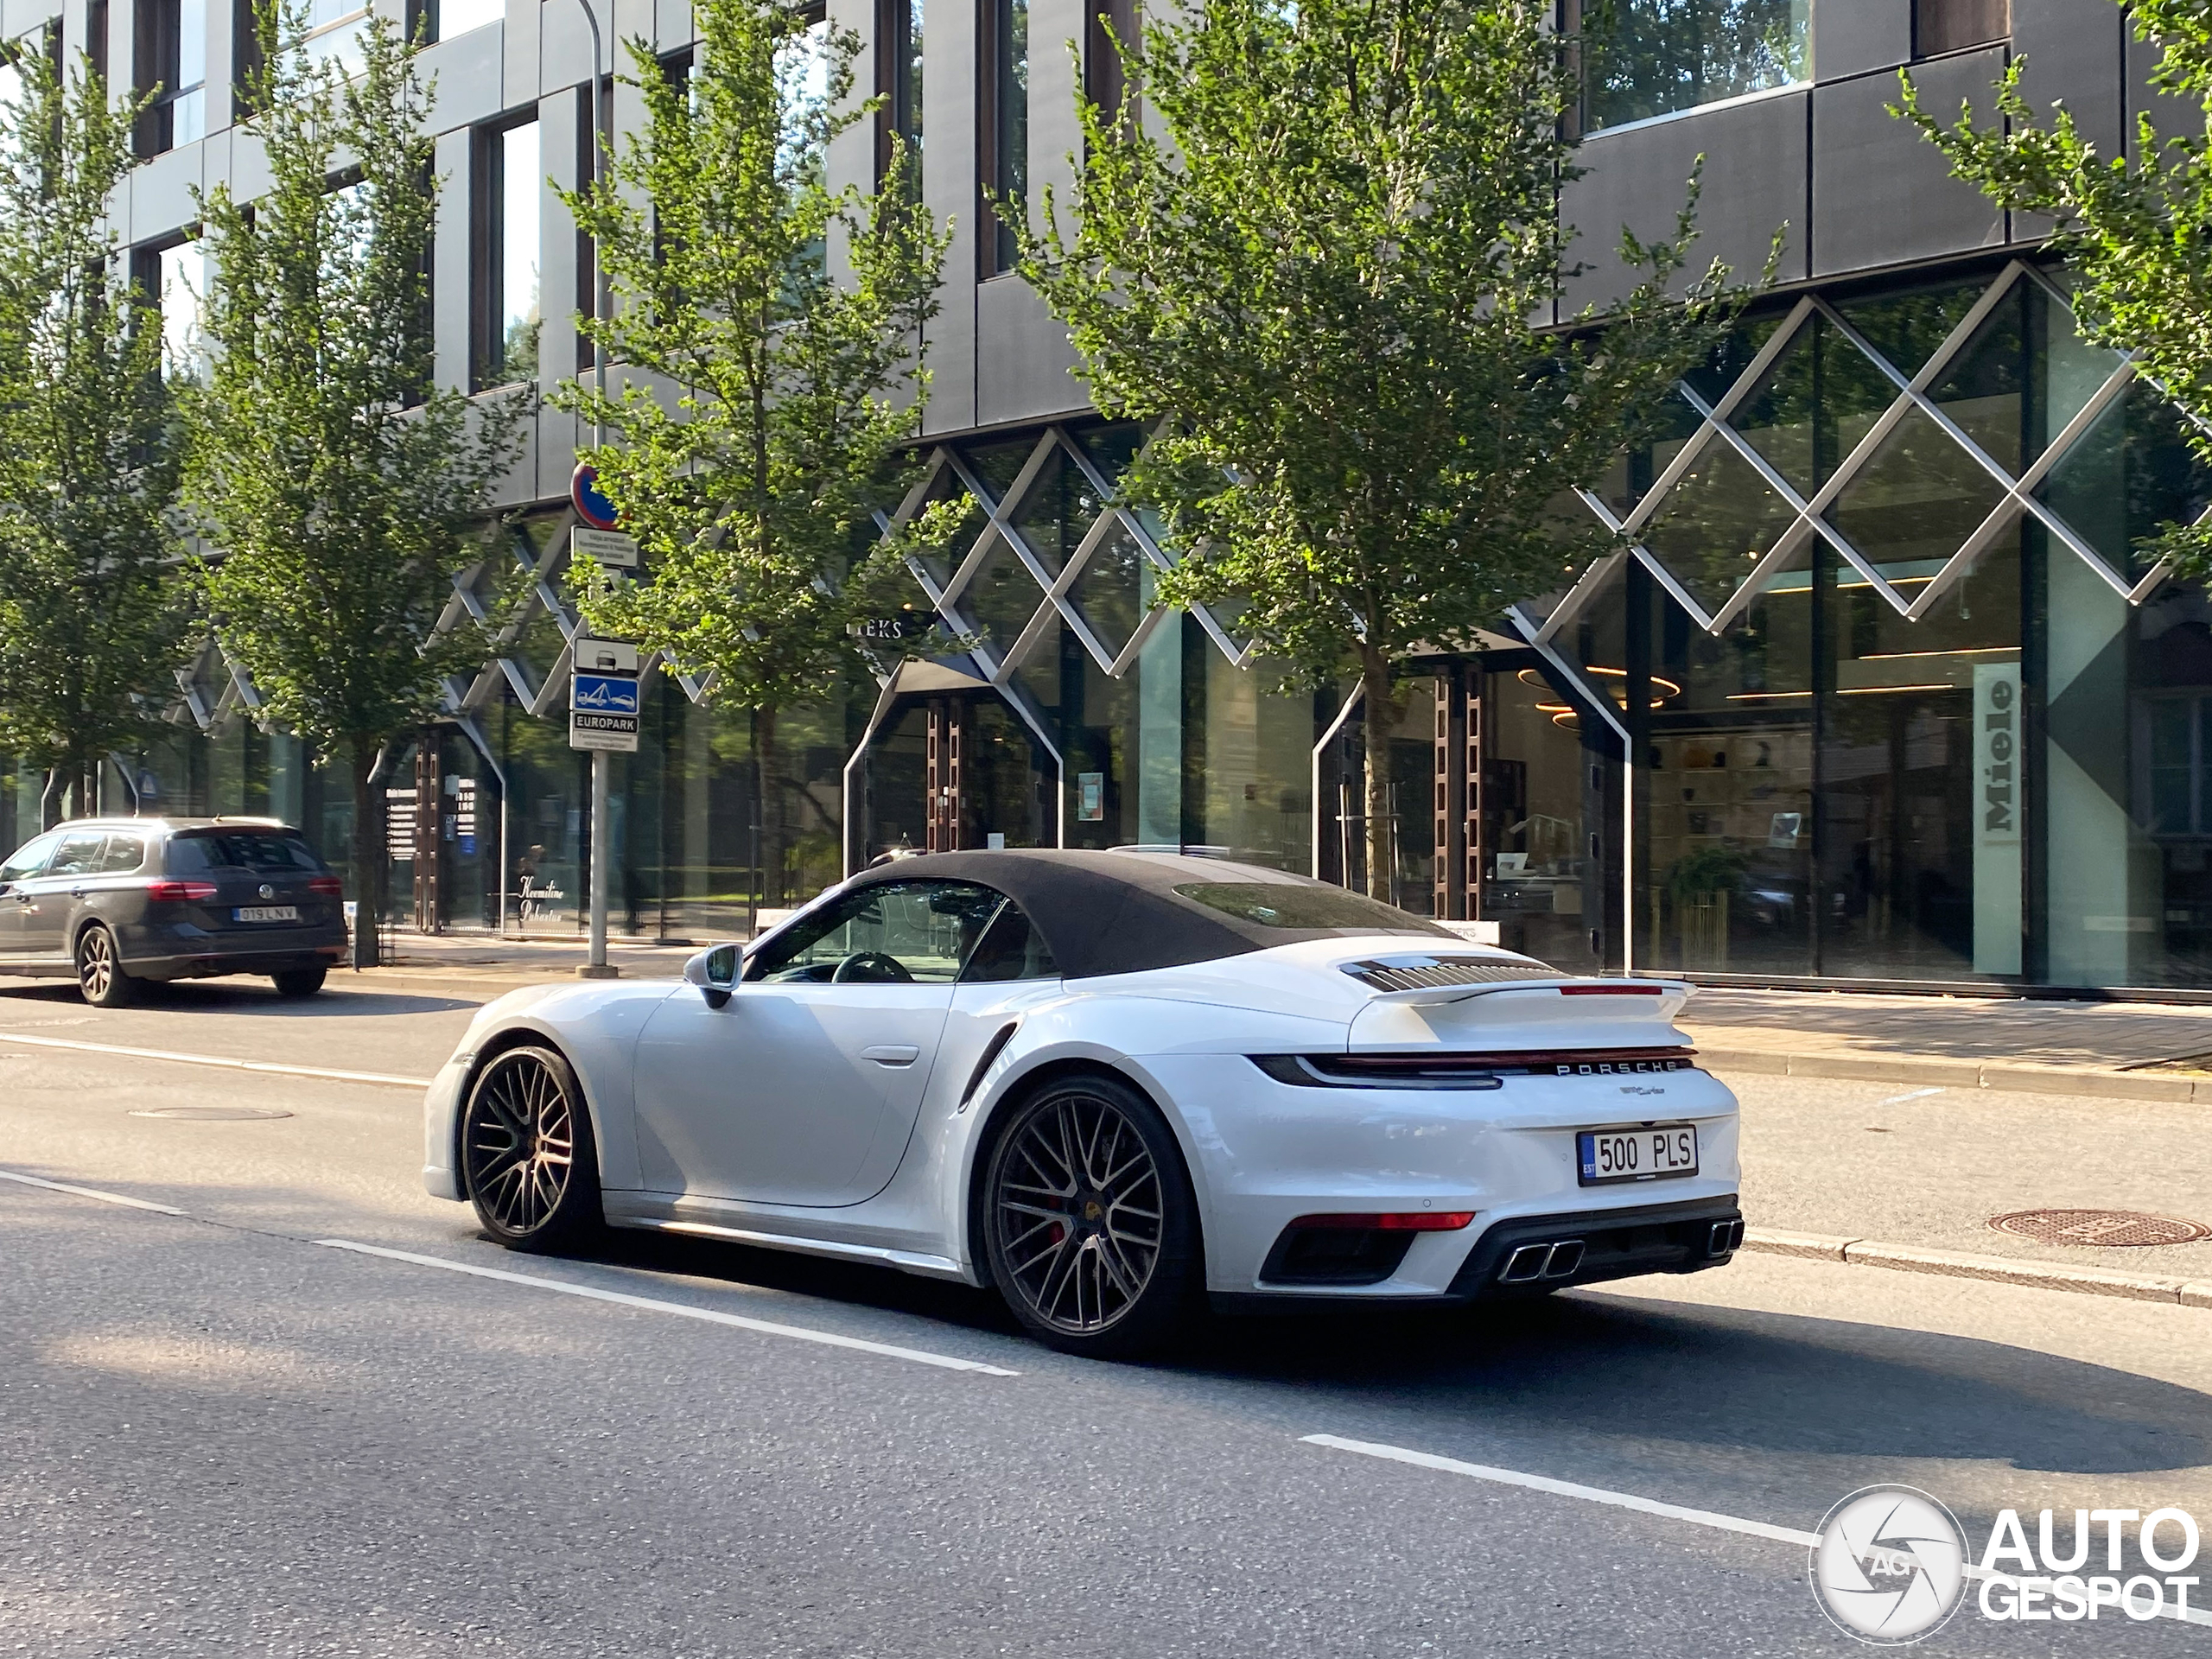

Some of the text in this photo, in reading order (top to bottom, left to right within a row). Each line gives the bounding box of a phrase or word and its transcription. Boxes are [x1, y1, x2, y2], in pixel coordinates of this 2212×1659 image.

[576, 715, 634, 731] EUROPARK
[1985, 680, 2012, 831] Miele
[1556, 1061, 1676, 1077] PORSCHE
[1599, 1132, 1691, 1173] 500 PLS
[1583, 1163, 1596, 1174] EST
